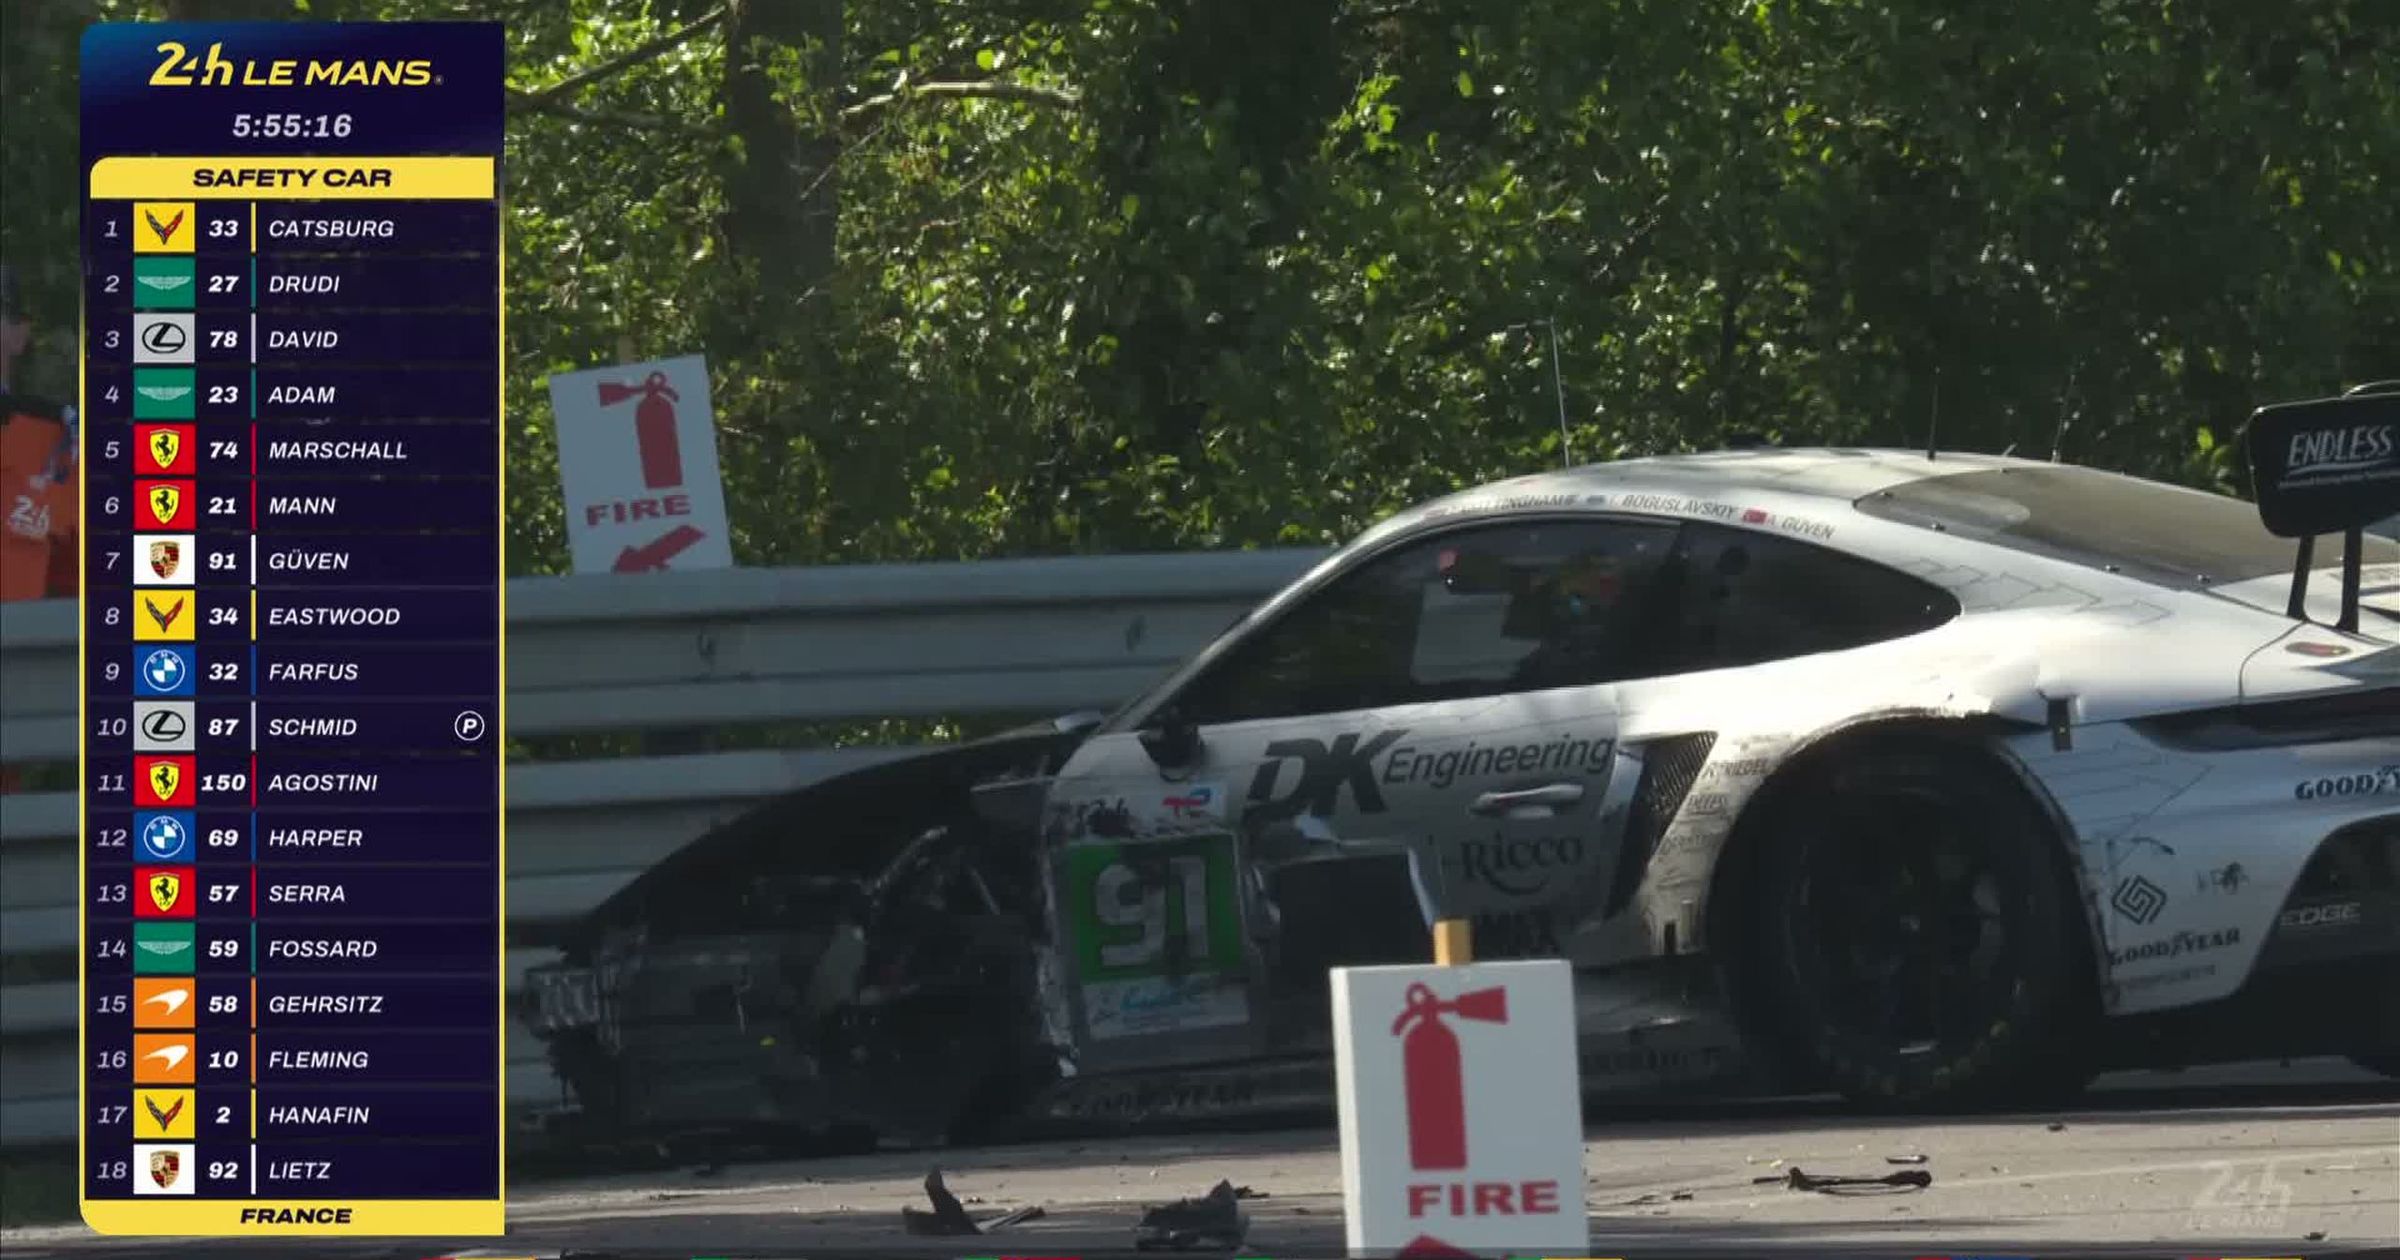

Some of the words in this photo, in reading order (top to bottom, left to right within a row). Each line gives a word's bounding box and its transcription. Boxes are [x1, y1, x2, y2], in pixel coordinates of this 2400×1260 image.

[2286, 423, 2393, 467] ENDLESS
[586, 494, 691, 526] FIRE
[1245, 729, 1411, 816] DK
[1383, 734, 1614, 788] Engineering
[1094, 855, 1209, 967] 91
[2110, 926, 2241, 966] GOODYEAR
[1407, 1179, 1561, 1219] FIRE
